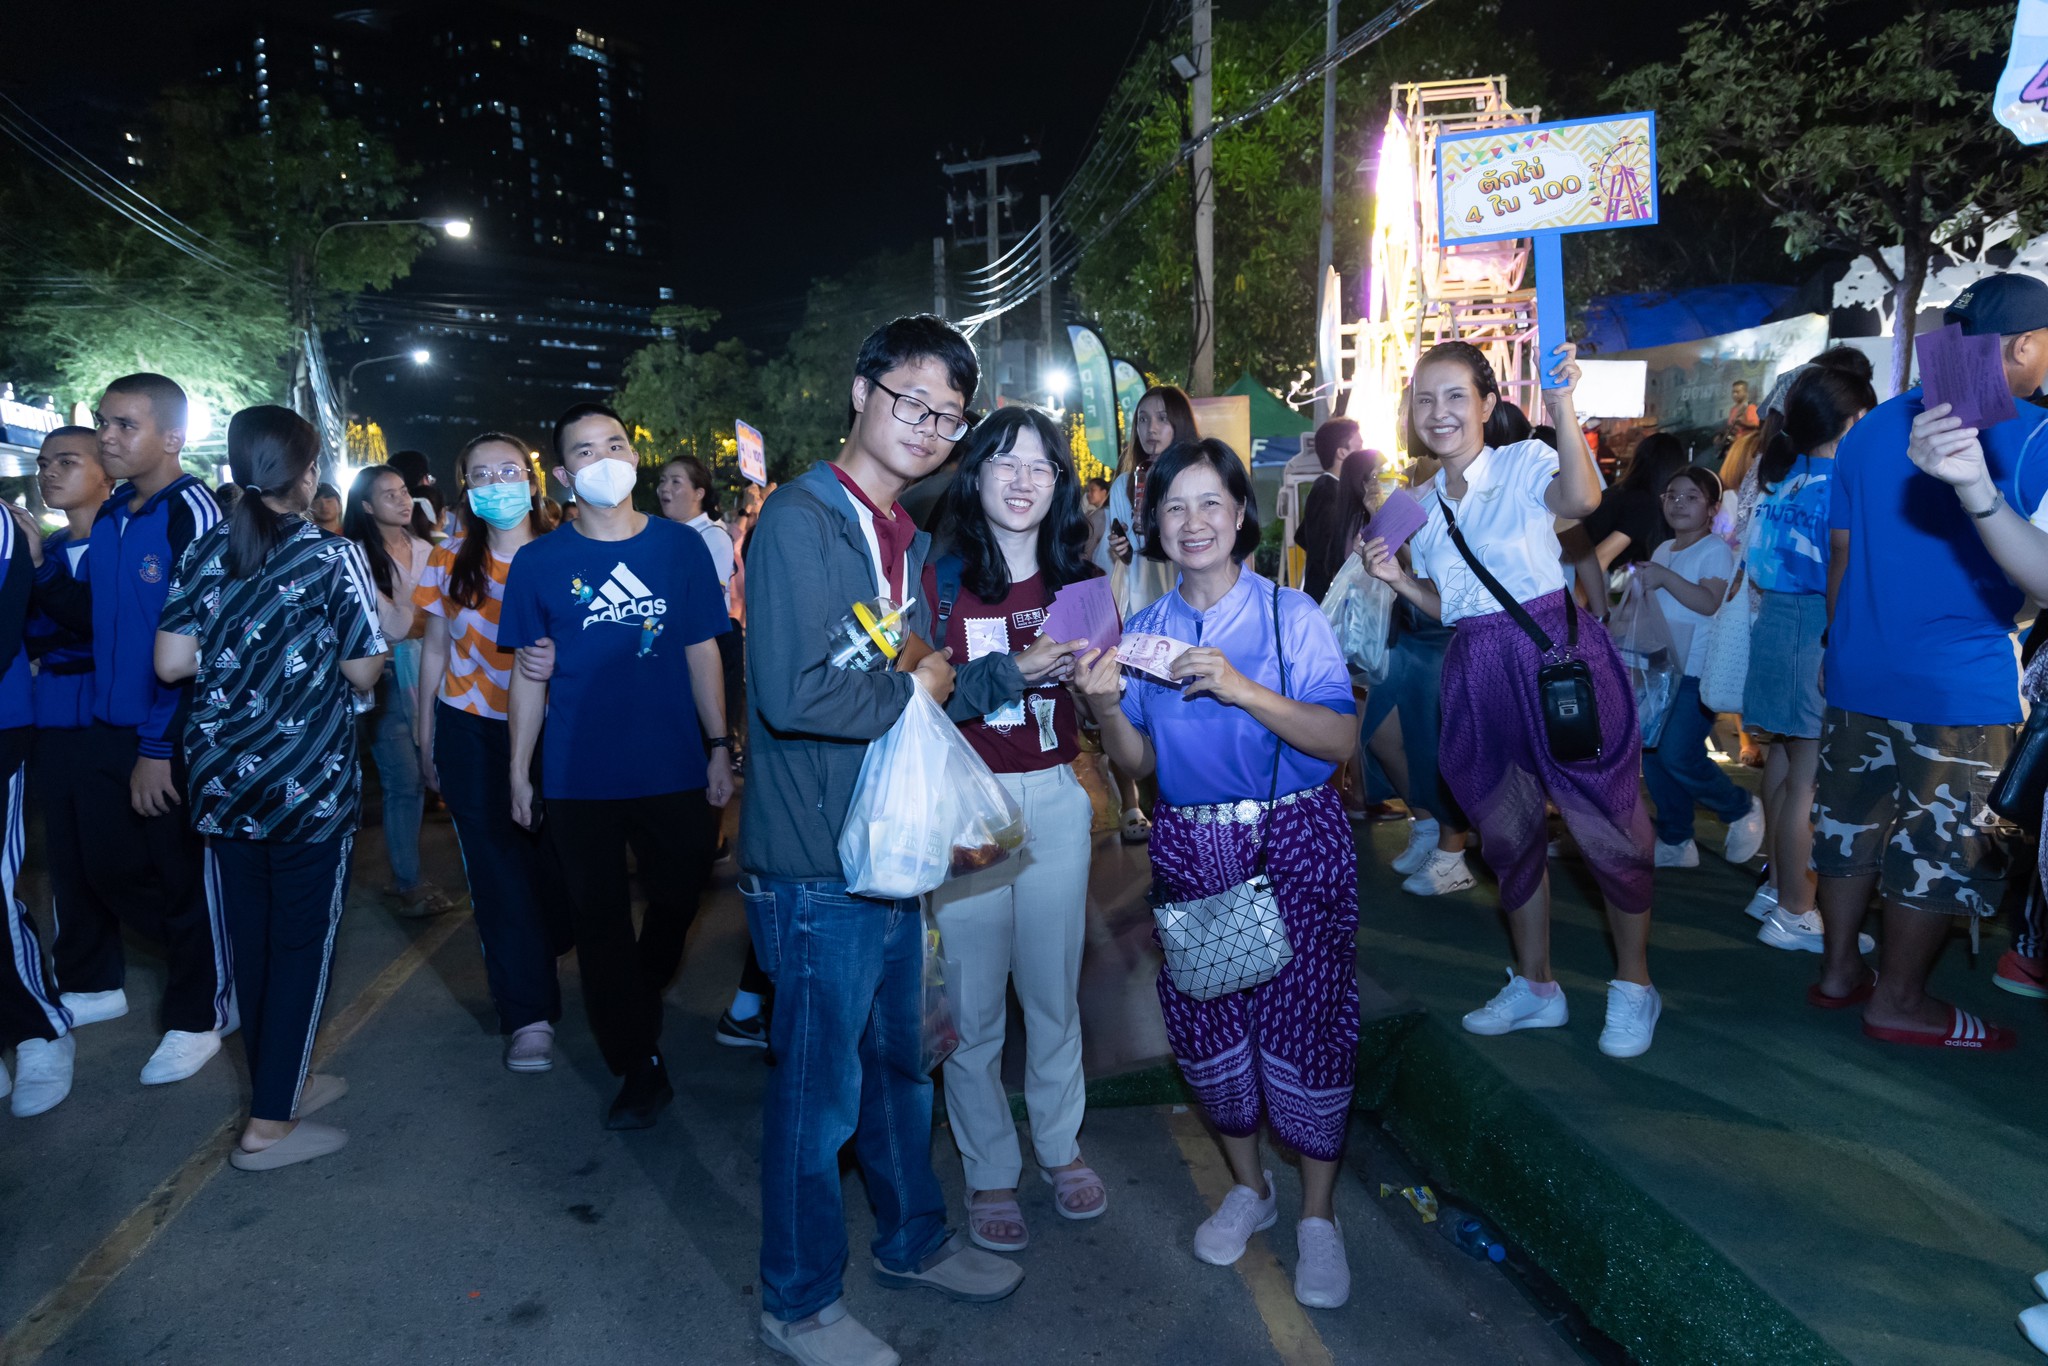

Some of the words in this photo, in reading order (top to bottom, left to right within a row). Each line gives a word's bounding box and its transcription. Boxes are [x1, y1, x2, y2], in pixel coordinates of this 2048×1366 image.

[1477, 156, 1545, 195] ตักไข่
[1465, 205, 1484, 224] 4
[1487, 195, 1521, 217] ใบ
[1529, 175, 1582, 205] 100
[582, 598, 667, 631] adidas
[1944, 1039, 1982, 1048] adidas
